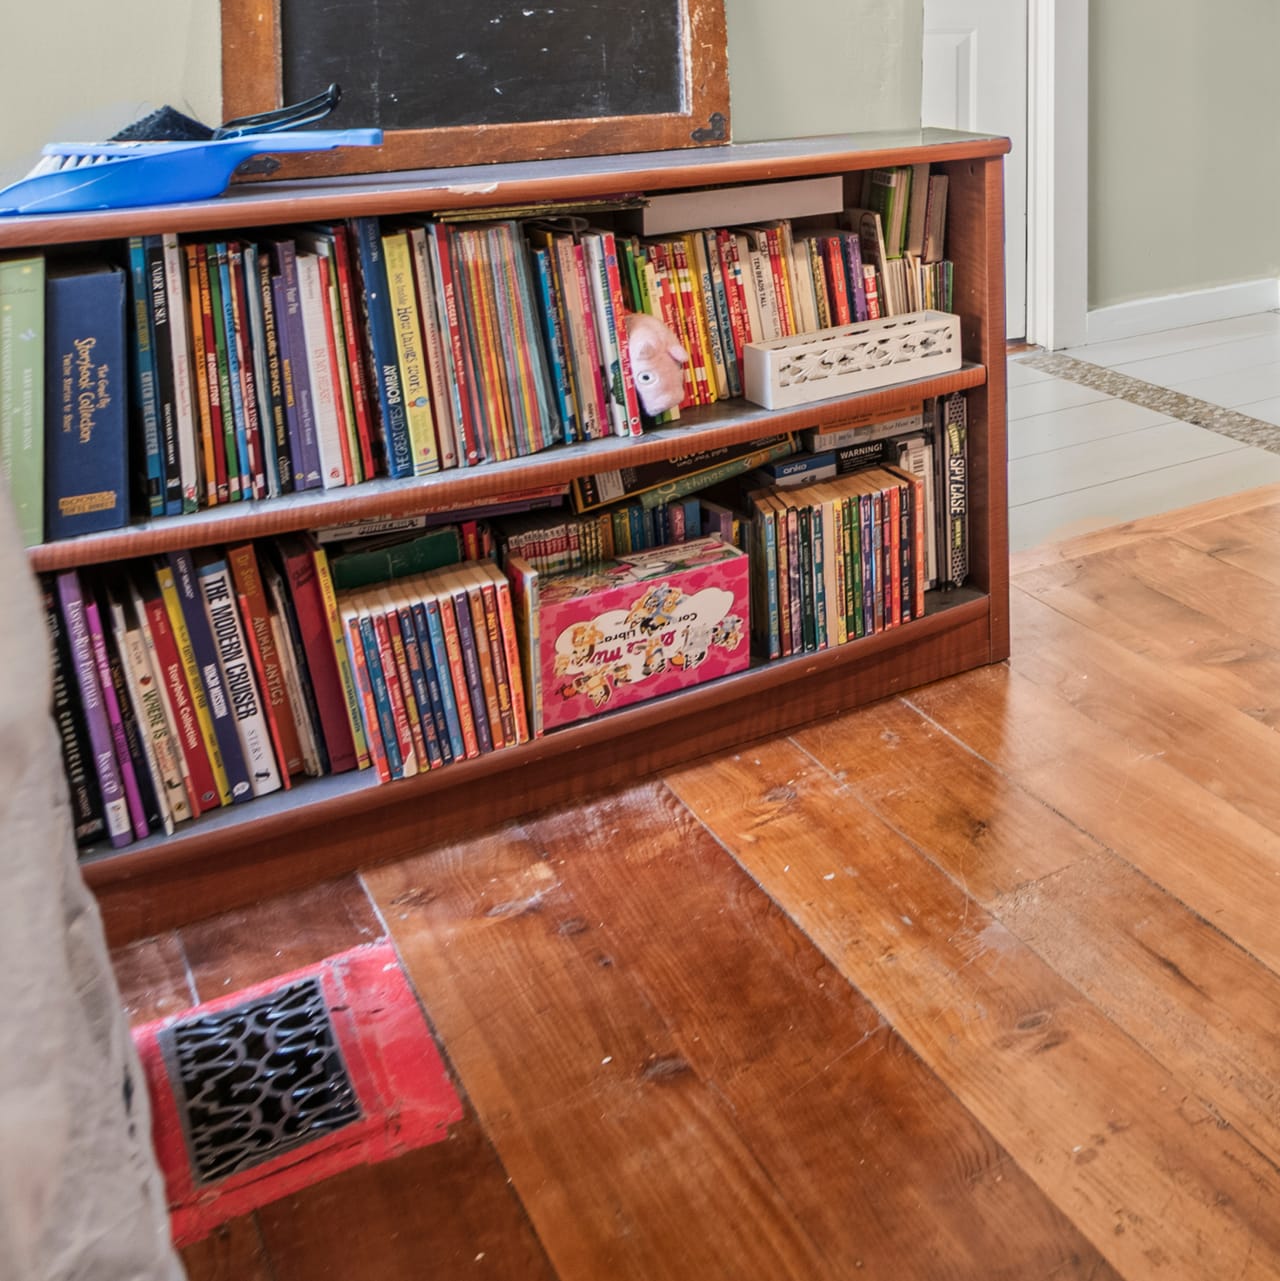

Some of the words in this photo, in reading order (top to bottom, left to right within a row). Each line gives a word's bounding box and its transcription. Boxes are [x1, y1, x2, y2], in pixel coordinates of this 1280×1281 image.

[151, 259, 165, 291] UNDER
[752, 256, 762, 270] TEN
[259, 266, 271, 286] THE
[754, 270, 765, 293] BEADS
[152, 291, 166, 306] THE
[444, 282, 453, 296] THE
[758, 292, 768, 309] TALL
[154, 306, 168, 326] SEA
[261, 286, 275, 330] COMPLETE
[397, 306, 414, 330] How
[265, 330, 277, 356] GUIDE
[402, 330, 419, 364] things
[73, 336, 98, 389] Storybook
[207, 352, 217, 363] AN
[268, 356, 278, 369] TO
[140, 369, 154, 398] CATCH
[208, 363, 219, 384] ORIGIN
[244, 372, 254, 383] AN
[269, 369, 281, 397] SPACE
[383, 363, 401, 405] BOMBAY
[407, 364, 424, 395] work
[142, 398, 156, 416] THE
[210, 384, 221, 407] STORY
[222, 386, 232, 410] ORIGIN
[232, 382, 242, 407] ORIGIN
[246, 383, 256, 408] ORIGIN
[78, 391, 97, 443] Collection
[224, 410, 234, 435] STORY
[234, 407, 245, 433] STORY
[248, 408, 258, 432] STORY
[144, 416, 160, 456] CREEPER
[392, 429, 406, 454] GREAT
[395, 453, 408, 472] THE
[839, 443, 884, 461] WARNING!
[683, 470, 725, 490] things
[783, 462, 808, 476] anko
[949, 459, 966, 483] SPY
[949, 483, 966, 515] CASE
[236, 553, 251, 568] Dr
[204, 575, 225, 606] THE
[242, 567, 259, 597] Seuss
[211, 607, 241, 664] MODERN
[252, 616, 274, 661] ANIMAL
[264, 663, 285, 707] ANTICS
[208, 688, 229, 719] MISSION
[226, 664, 258, 721] CRUISER
[142, 688, 160, 728] WHERE
[153, 730, 166, 741] IS
[168, 663, 188, 708] Storybook
[180, 707, 198, 750] Collection
[247, 728, 264, 761] STERN
[104, 780, 119, 795] CD
